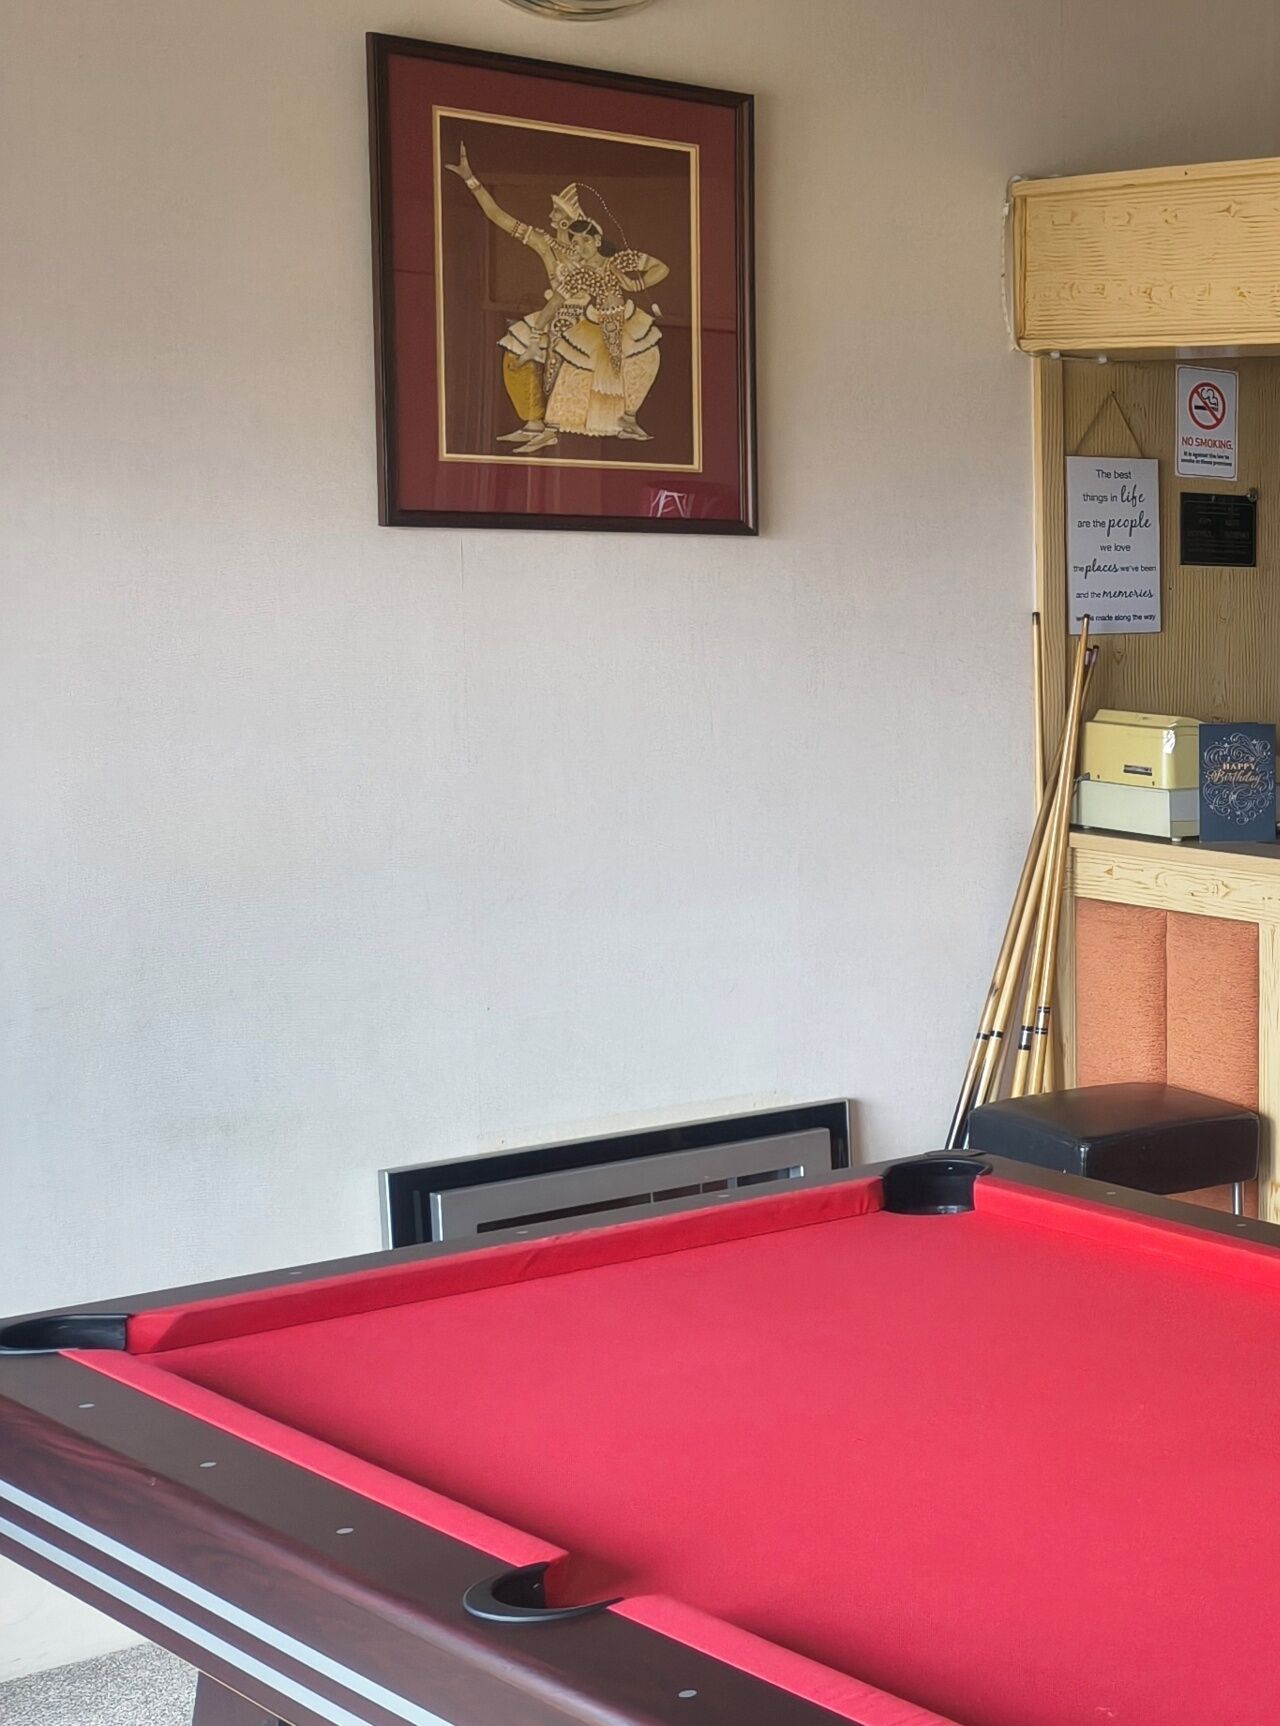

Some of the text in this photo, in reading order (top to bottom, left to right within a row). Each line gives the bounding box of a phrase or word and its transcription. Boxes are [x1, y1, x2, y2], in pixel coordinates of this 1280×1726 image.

[1182, 436, 1194, 446] NO
[1096, 469, 1132, 479] The best
[1083, 484, 1146, 507] things in life
[1077, 510, 1151, 537] are the people
[1084, 558, 1119, 579] places
[1102, 589, 1153, 598] memories
[1115, 614, 1131, 622] along
[1208, 769, 1264, 788] Birthday
